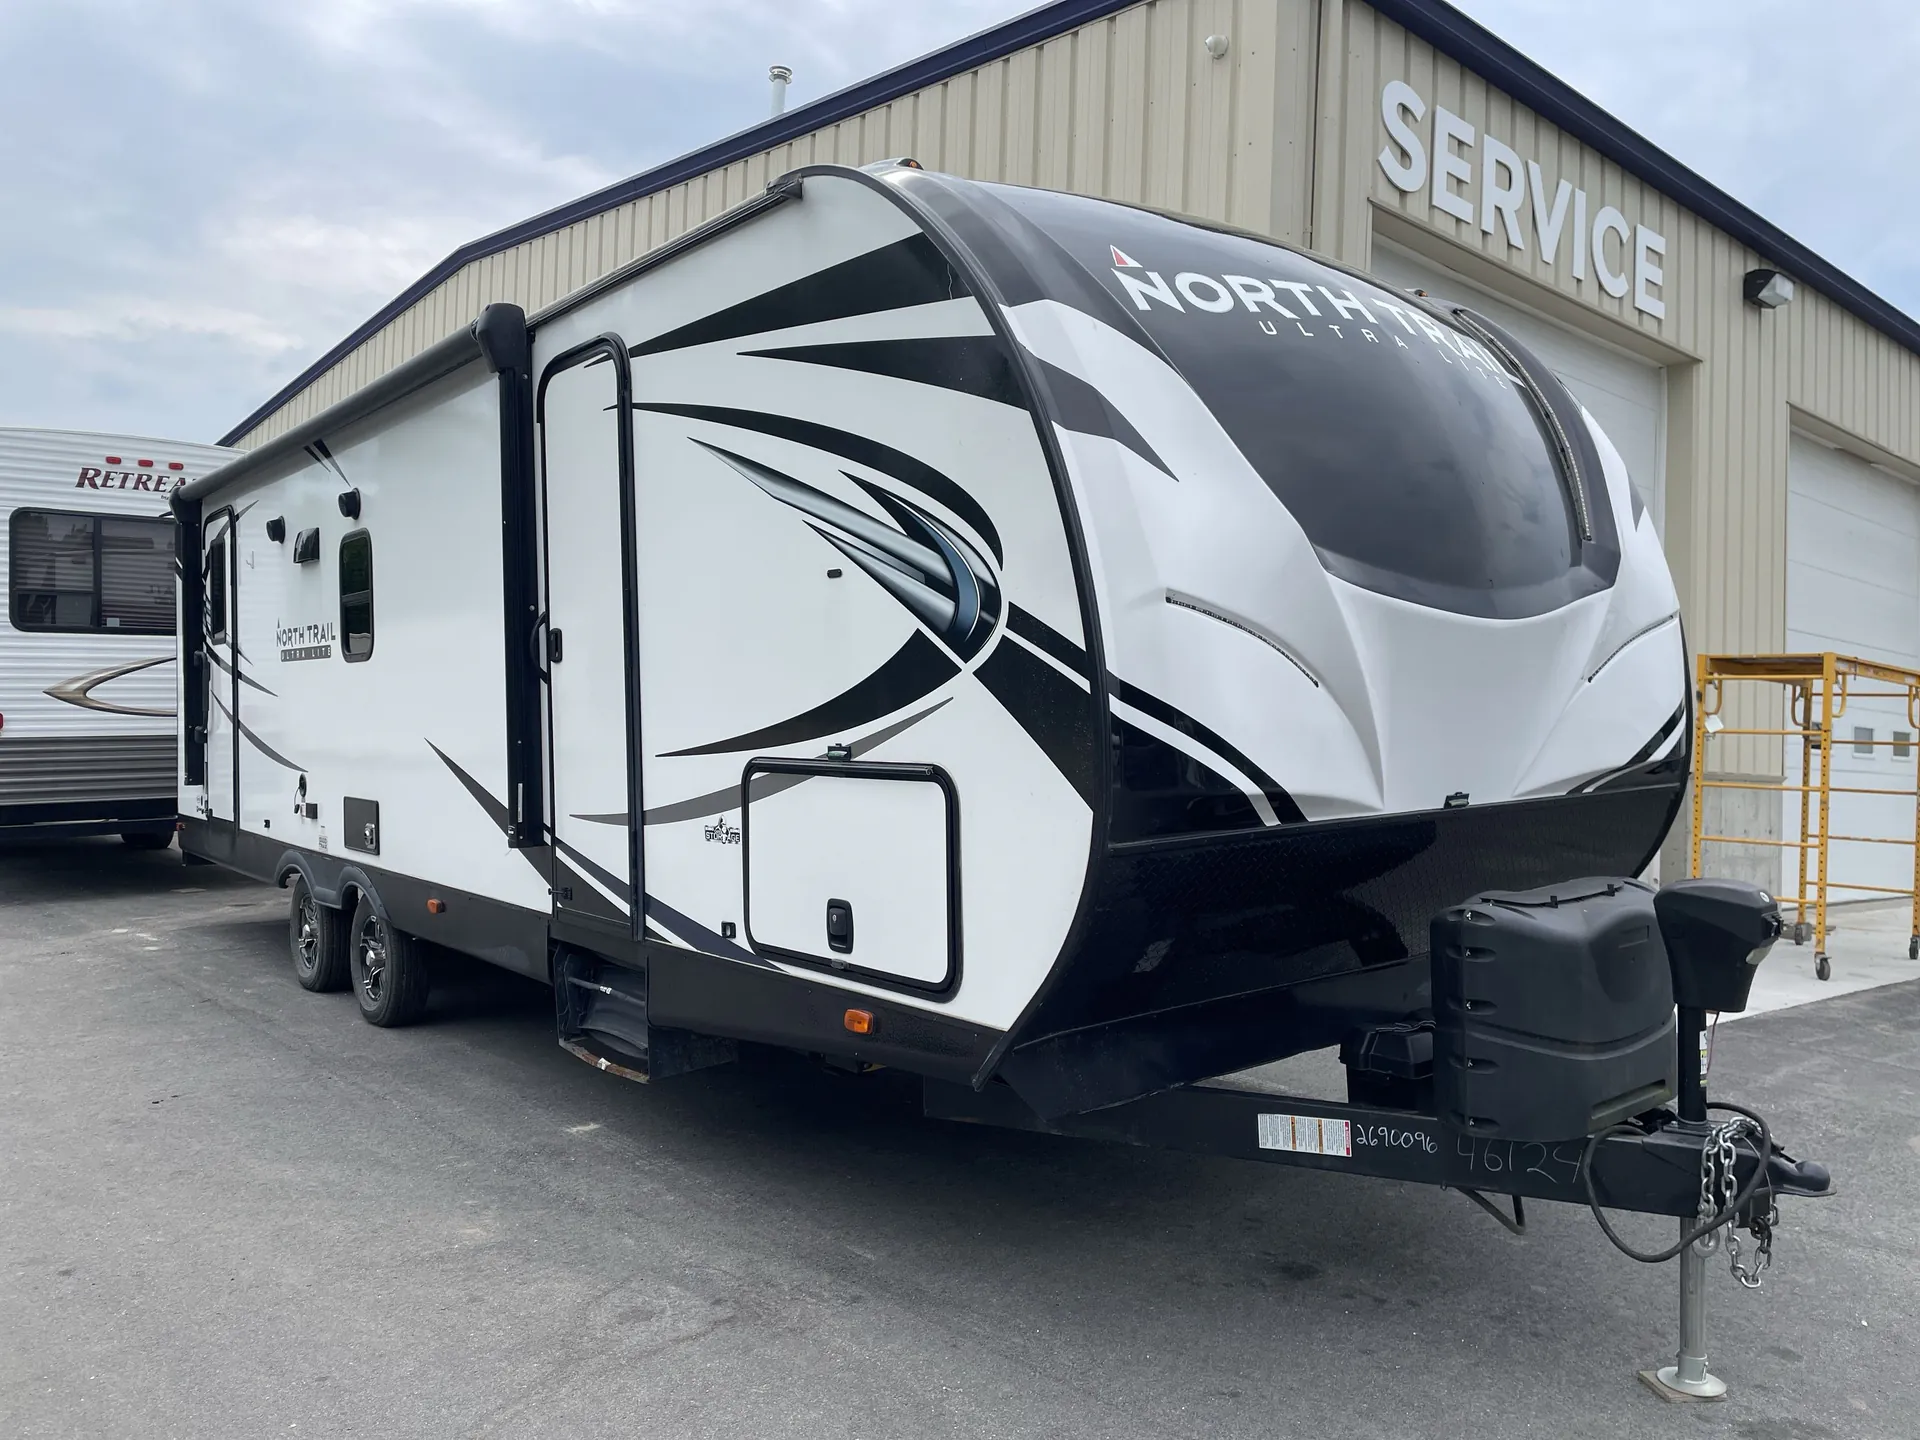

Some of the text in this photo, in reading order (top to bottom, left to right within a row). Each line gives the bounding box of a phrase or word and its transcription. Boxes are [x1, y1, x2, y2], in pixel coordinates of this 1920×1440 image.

[1376, 80, 1666, 320] SERVICE
[1111, 267, 1527, 388] NORTH TRAIL
[1259, 320, 1508, 390] ULTRA LITE
[75, 467, 196, 493] RETREA
[276, 622, 336, 647] NORTH TRAIL
[281, 647, 331, 660] ULTRA LITE
[1356, 1123, 1438, 1154] 2690096
